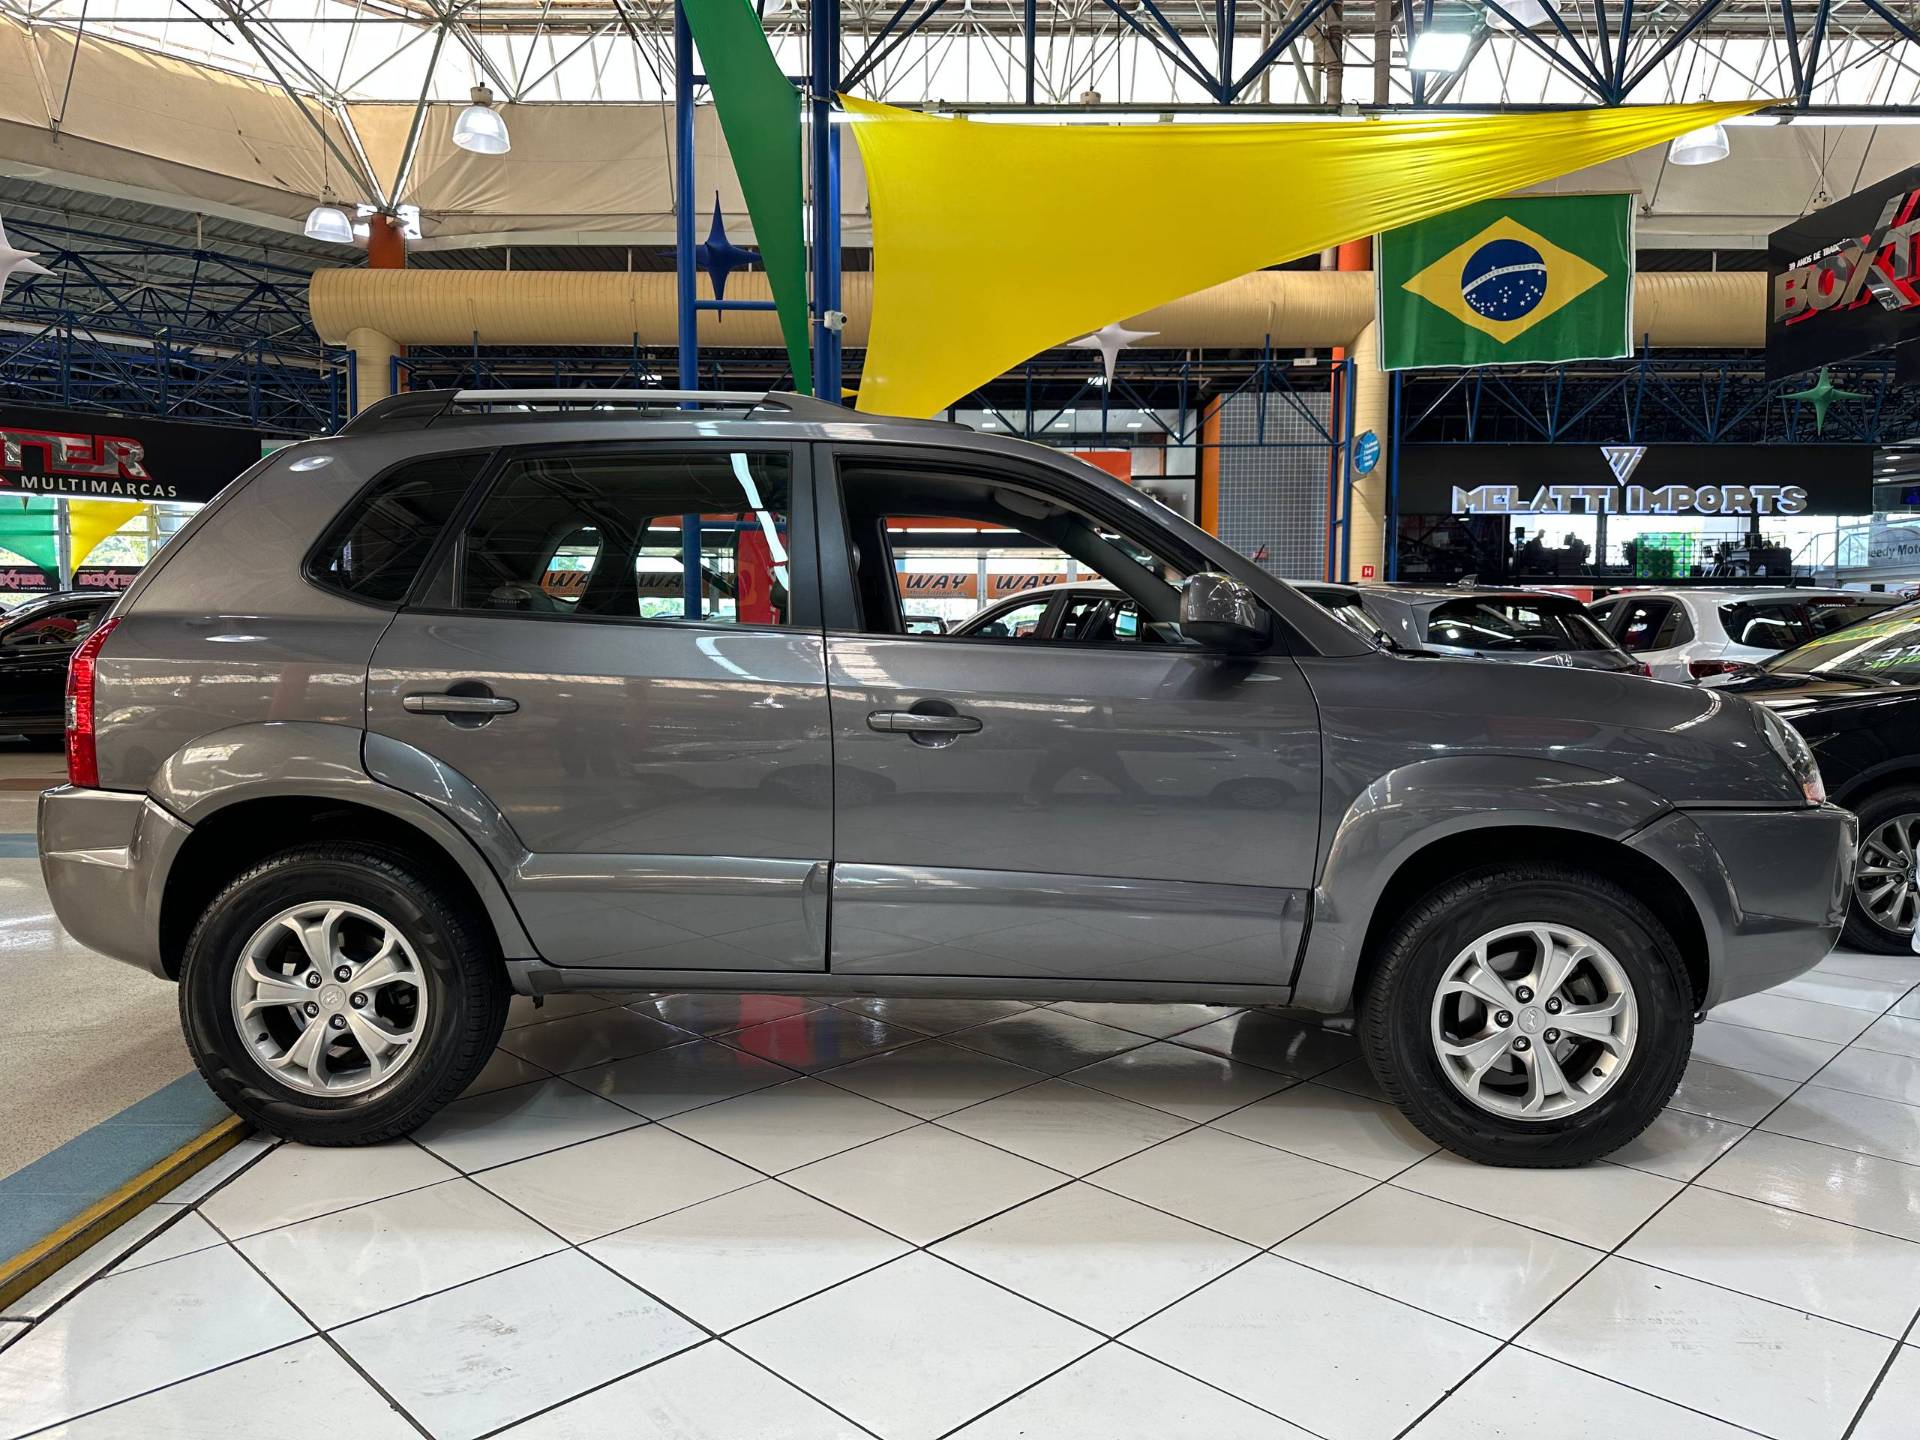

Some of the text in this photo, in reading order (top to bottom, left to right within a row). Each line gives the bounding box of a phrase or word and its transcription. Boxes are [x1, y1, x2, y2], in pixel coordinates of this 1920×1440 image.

[1813, 250, 1822, 261] DE
[20, 475, 178, 498] MULTIMARCAS
[1452, 485, 1808, 515] MELATTI IMPORTS
[905, 575, 967, 589] WAY
